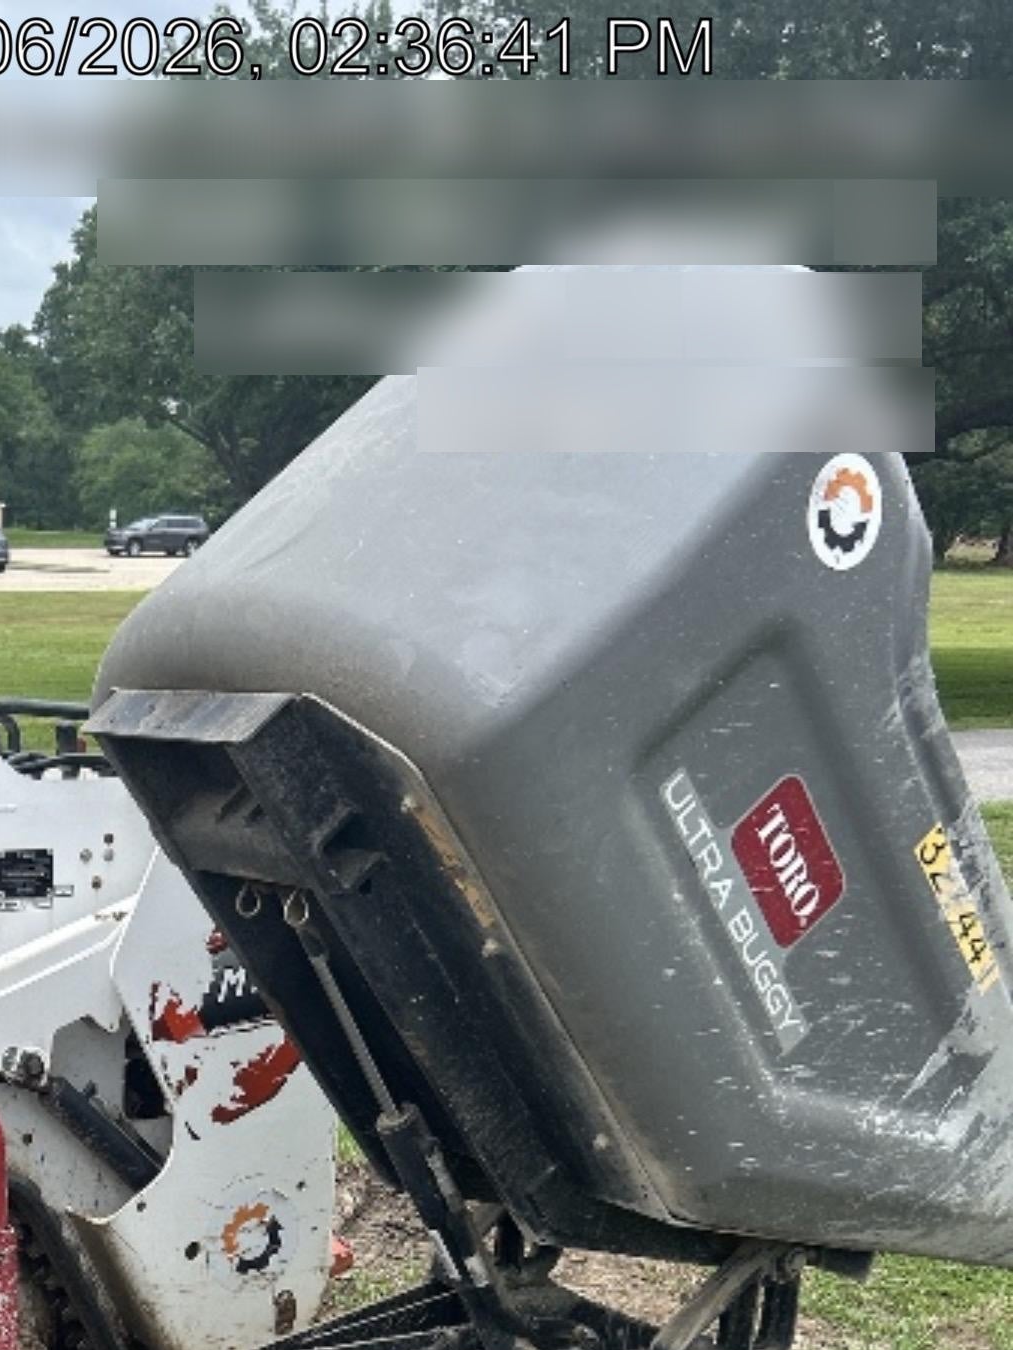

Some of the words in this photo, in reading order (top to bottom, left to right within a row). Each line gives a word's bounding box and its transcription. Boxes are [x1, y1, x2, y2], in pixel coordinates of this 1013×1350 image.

[663, 772, 734, 911] ULTRA
[728, 906, 802, 1031] BUGGY
[756, 802, 820, 918] TORO
